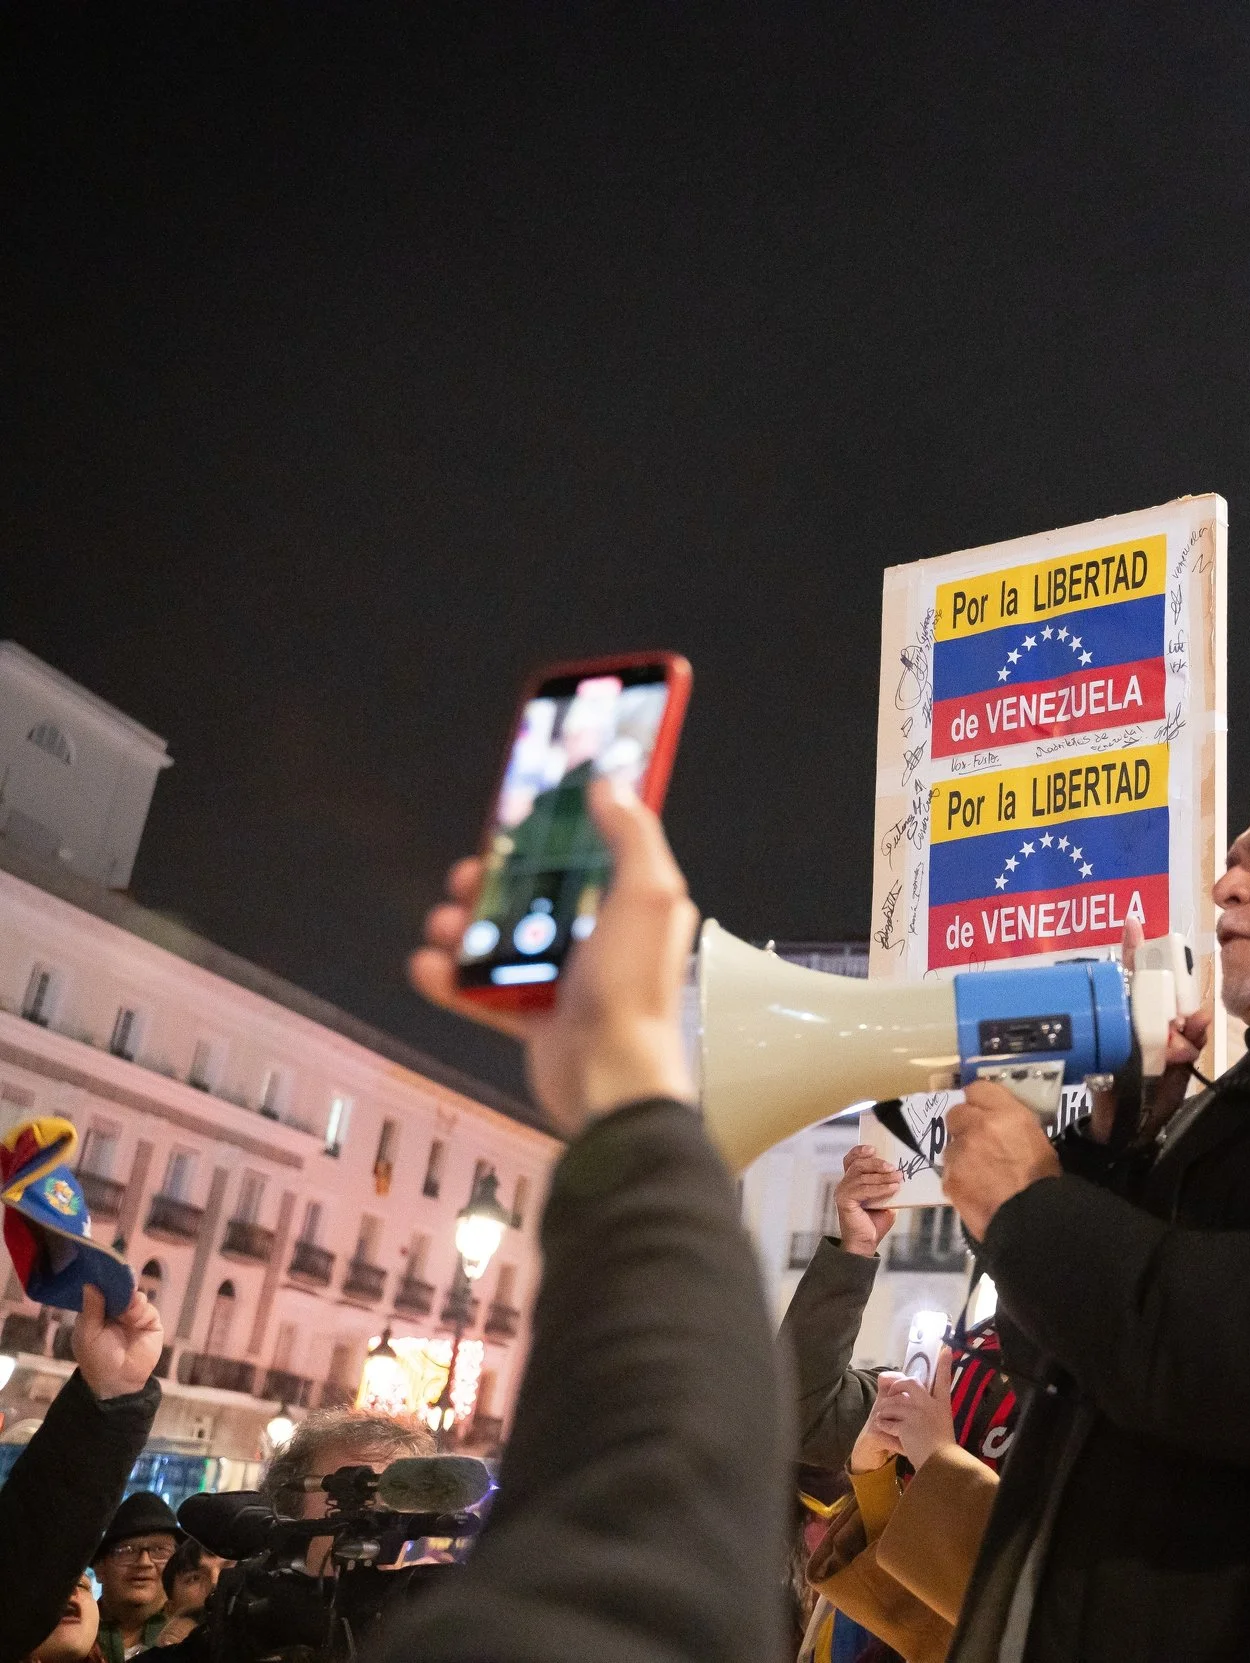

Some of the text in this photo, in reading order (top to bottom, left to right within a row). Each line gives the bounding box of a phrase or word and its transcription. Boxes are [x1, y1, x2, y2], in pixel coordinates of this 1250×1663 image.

[952, 591, 988, 629] Por
[1000, 580, 1018, 617] la
[1034, 550, 1148, 611] LIBERTAD
[951, 708, 979, 742] de
[985, 675, 1143, 735] VENEZUELA
[948, 758, 1150, 830] Por la LIBERTAD
[946, 890, 1146, 950] de VENEZUELA
